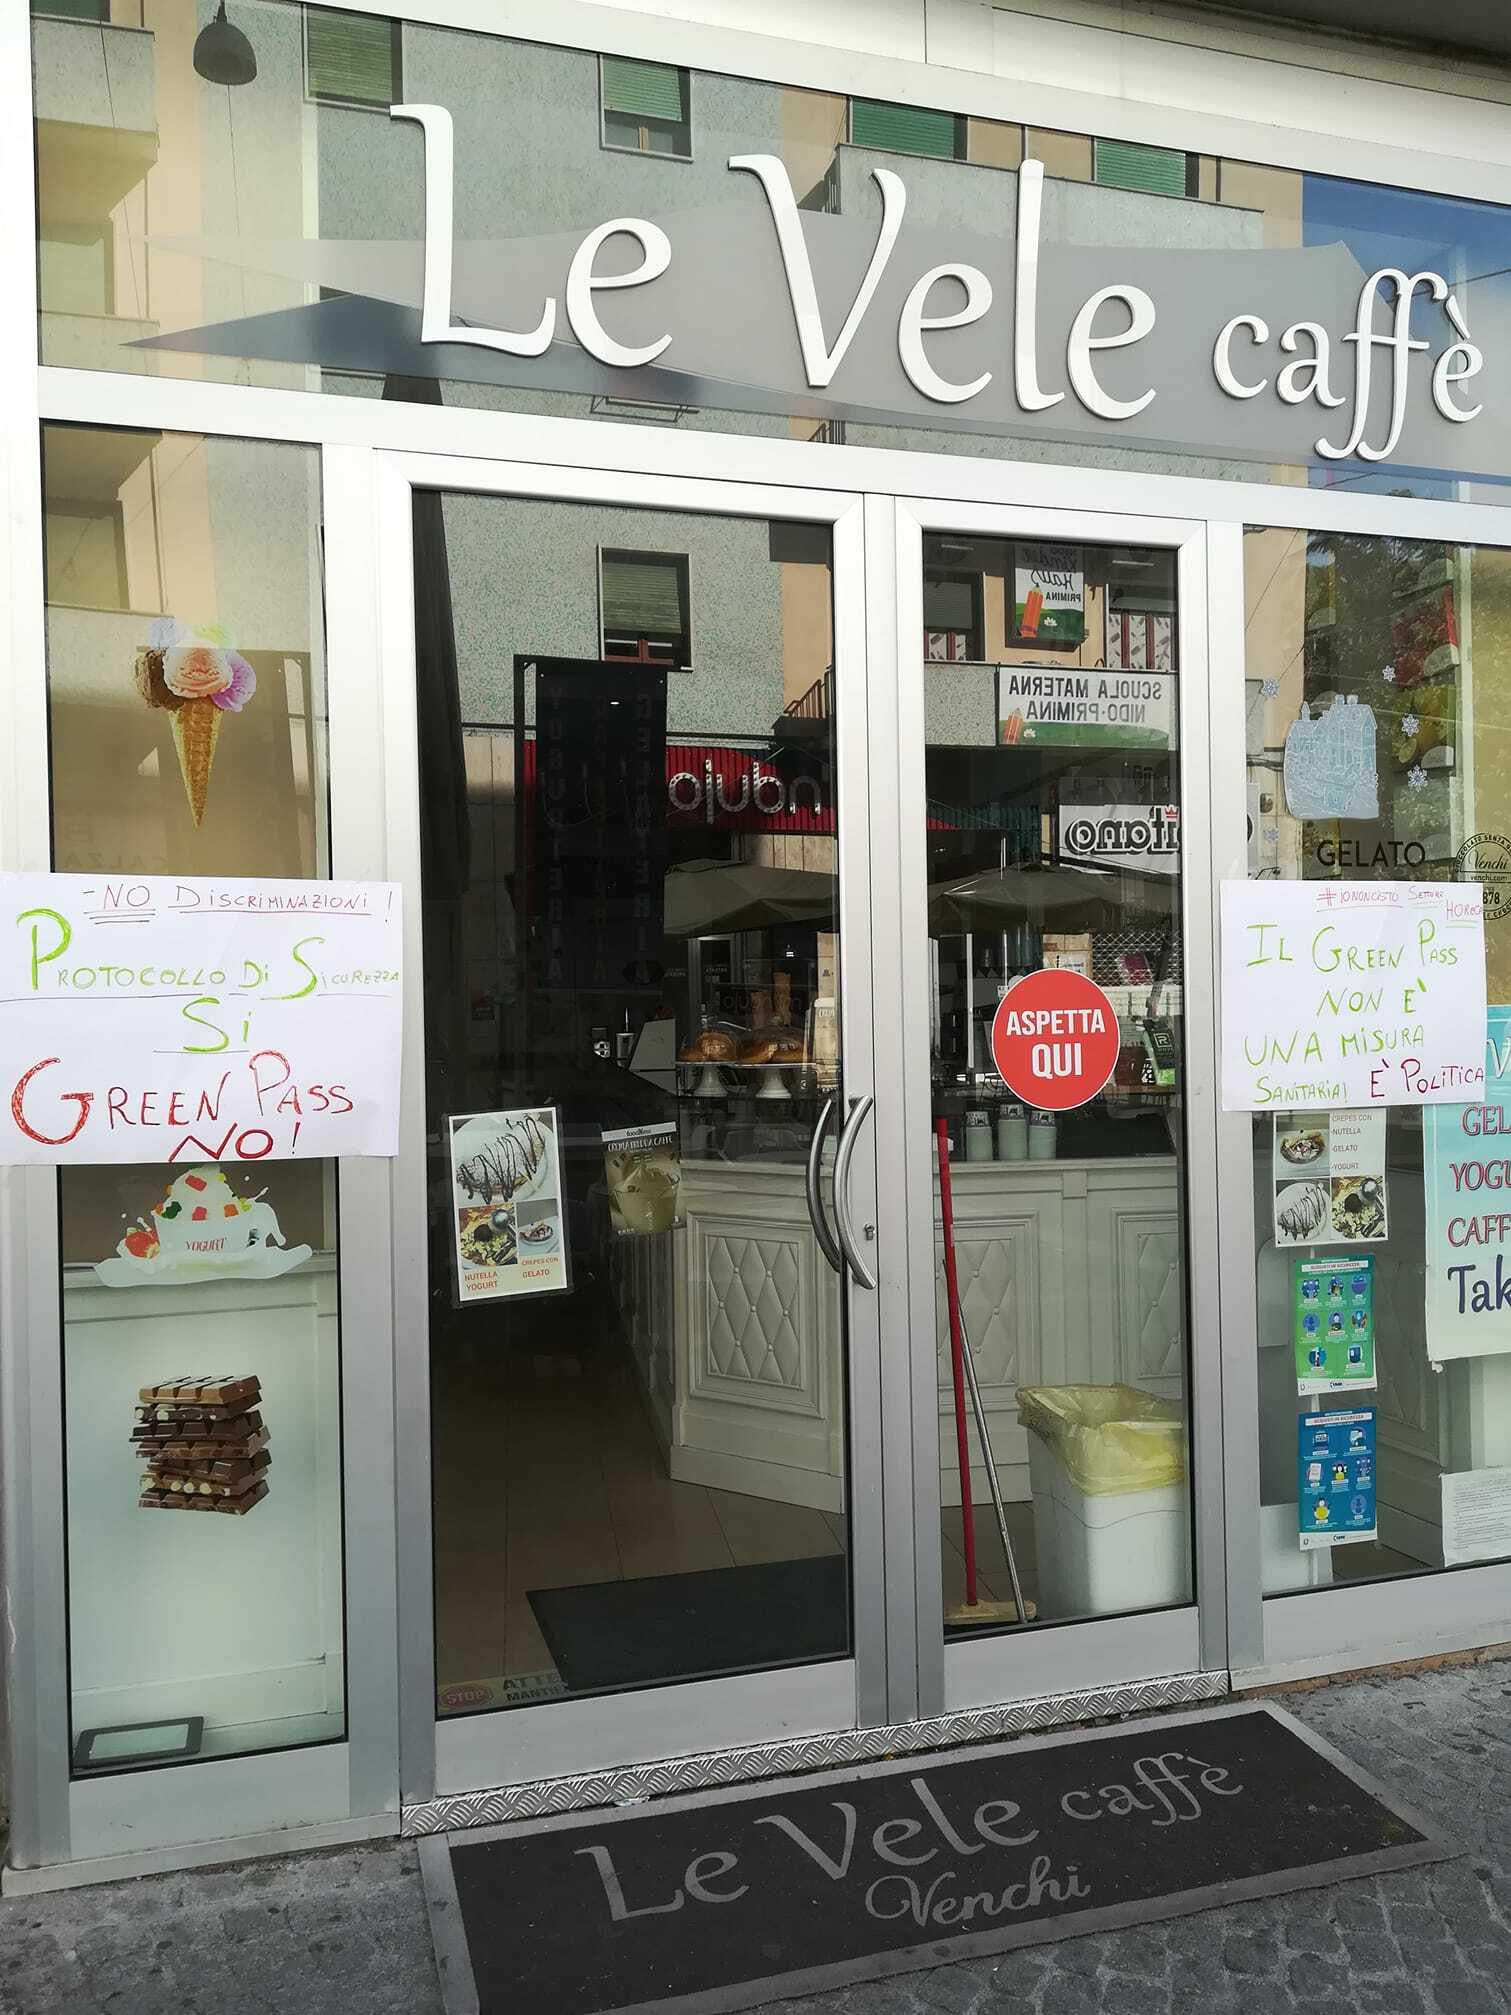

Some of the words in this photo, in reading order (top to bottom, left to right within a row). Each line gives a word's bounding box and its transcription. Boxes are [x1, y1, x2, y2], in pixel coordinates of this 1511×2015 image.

[390, 104, 673, 367] Le
[728, 154, 1157, 420] Vele
[1214, 267, 1483, 461] caffè
[1316, 840, 1426, 868] GELATO
[1468, 849, 1508, 870] Venchi
[1483, 892, 1500, 904] 878
[1317, 988, 1383, 1016] NON
[1006, 1009, 1105, 1036] ASPETTA
[1032, 1043, 1082, 1079] QUI
[1244, 1031, 1322, 1066] UNA
[464, 1272, 498, 1282] NUTELLA
[466, 1281, 498, 1292] YOGURT
[522, 1269, 550, 1279] GELATO
[1448, 1254, 1511, 1314] Tak
[447, 1690, 487, 1704] STOP
[575, 1844, 750, 1921] Le
[755, 1778, 1039, 1881] Vele
[1061, 1752, 1243, 1827] caffè
[864, 1855, 1091, 1928] Venchi
